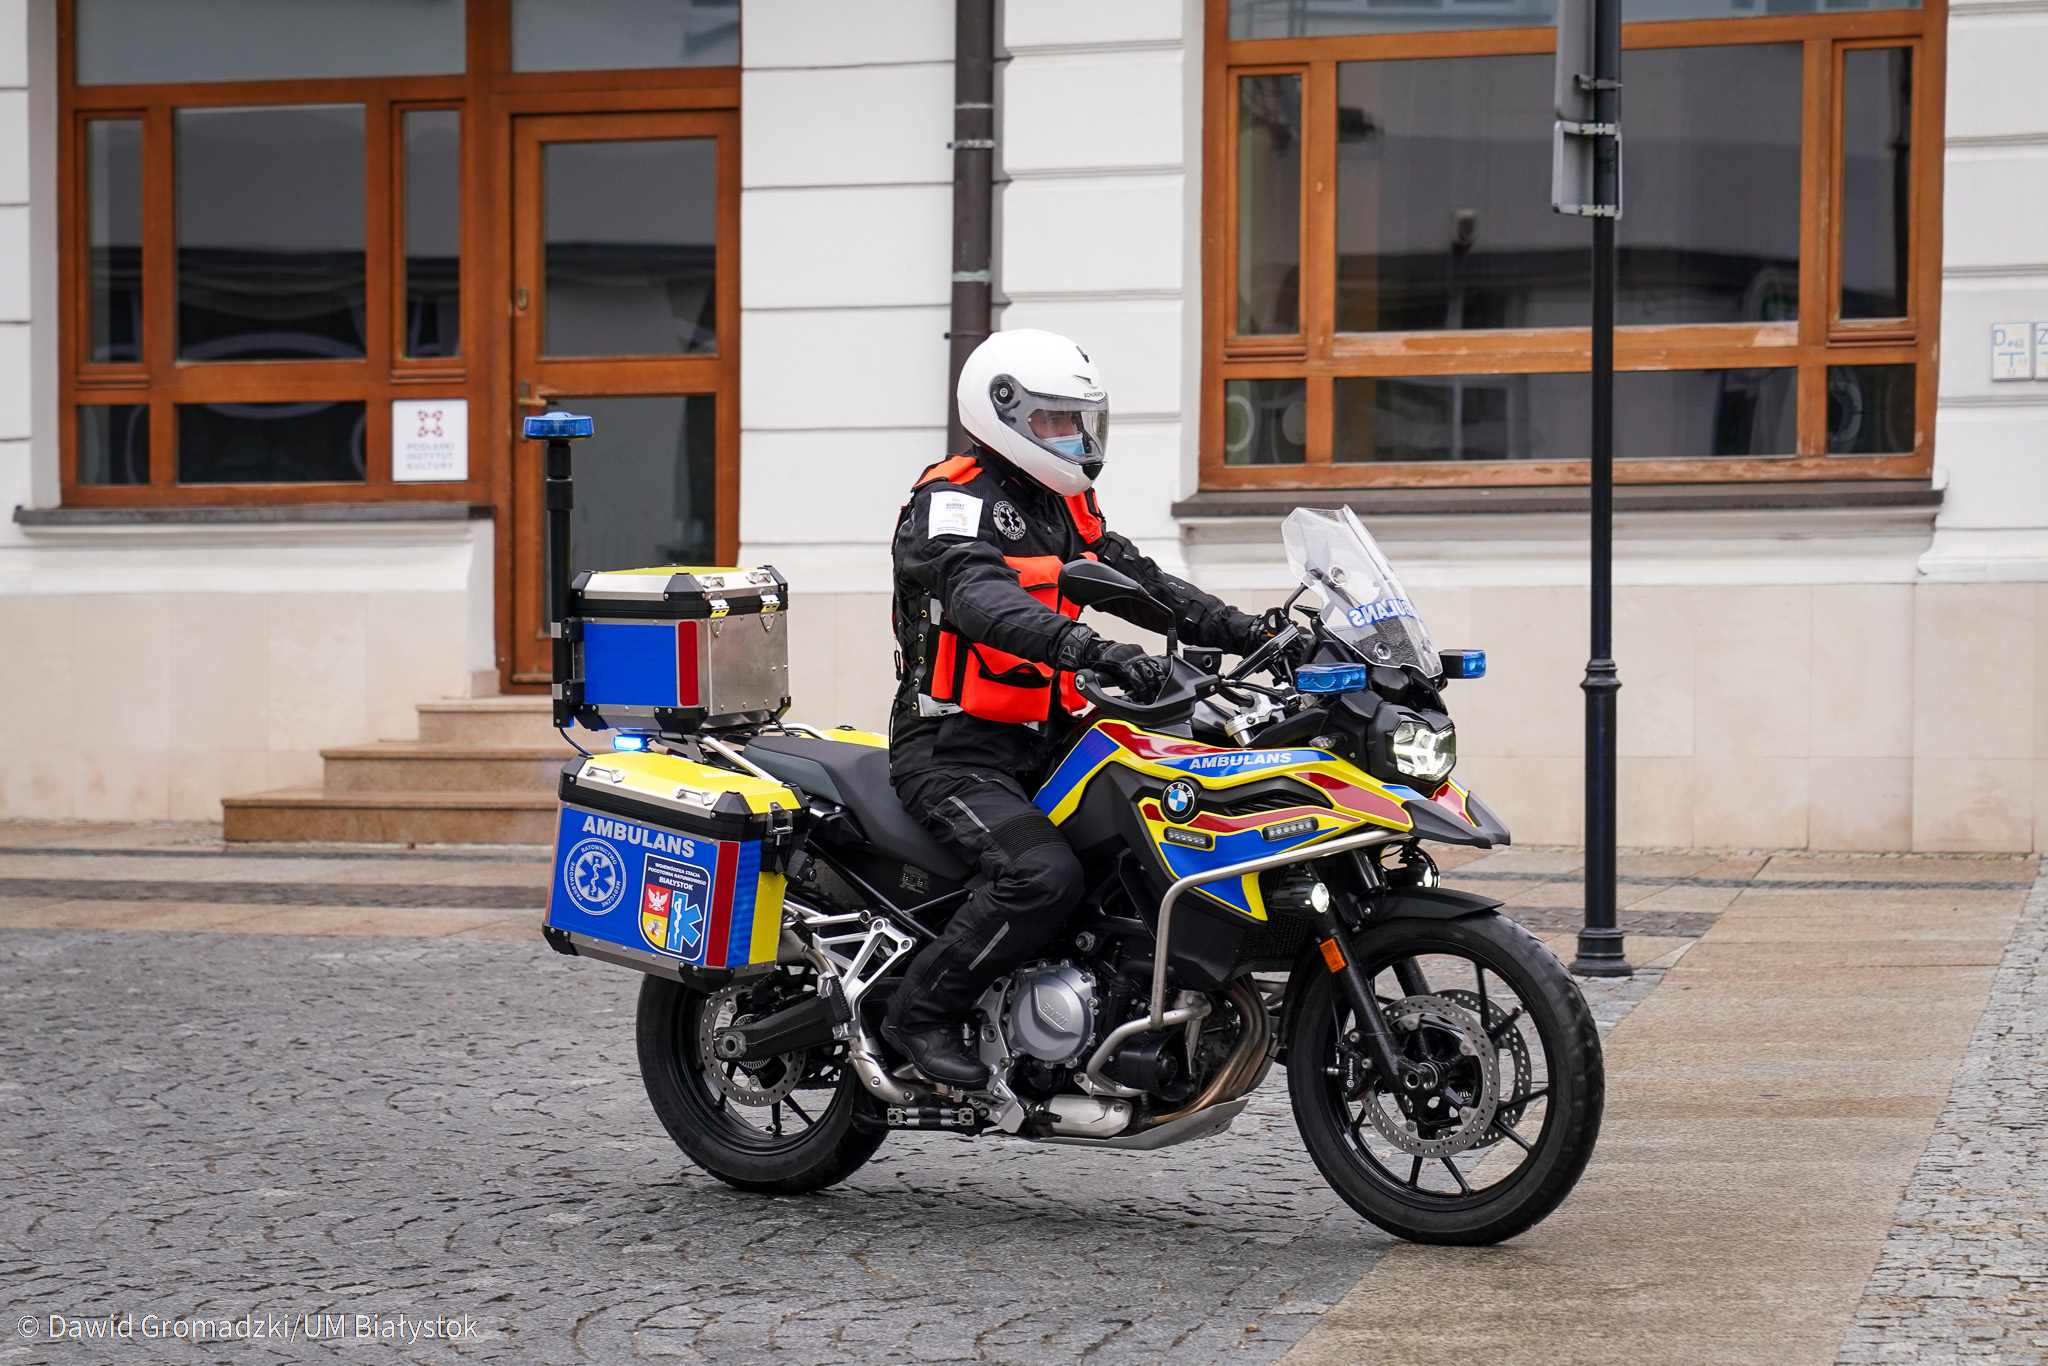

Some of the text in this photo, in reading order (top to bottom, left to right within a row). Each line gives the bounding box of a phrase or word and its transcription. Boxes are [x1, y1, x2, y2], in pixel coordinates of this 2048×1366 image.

[407, 452, 453, 461] INSTYTUT
[407, 462, 454, 471] KULTURY
[1188, 753, 1292, 770] AMBULANS
[1167, 783, 1193, 798] BMW
[582, 815, 695, 858] AMBULANS
[580, 844, 618, 865] RATOWNICTWO
[658, 876, 694, 891] BIAŁYSTOK
[601, 880, 621, 908] MEDYCZNE
[1042, 1003, 1068, 1027] BMW
